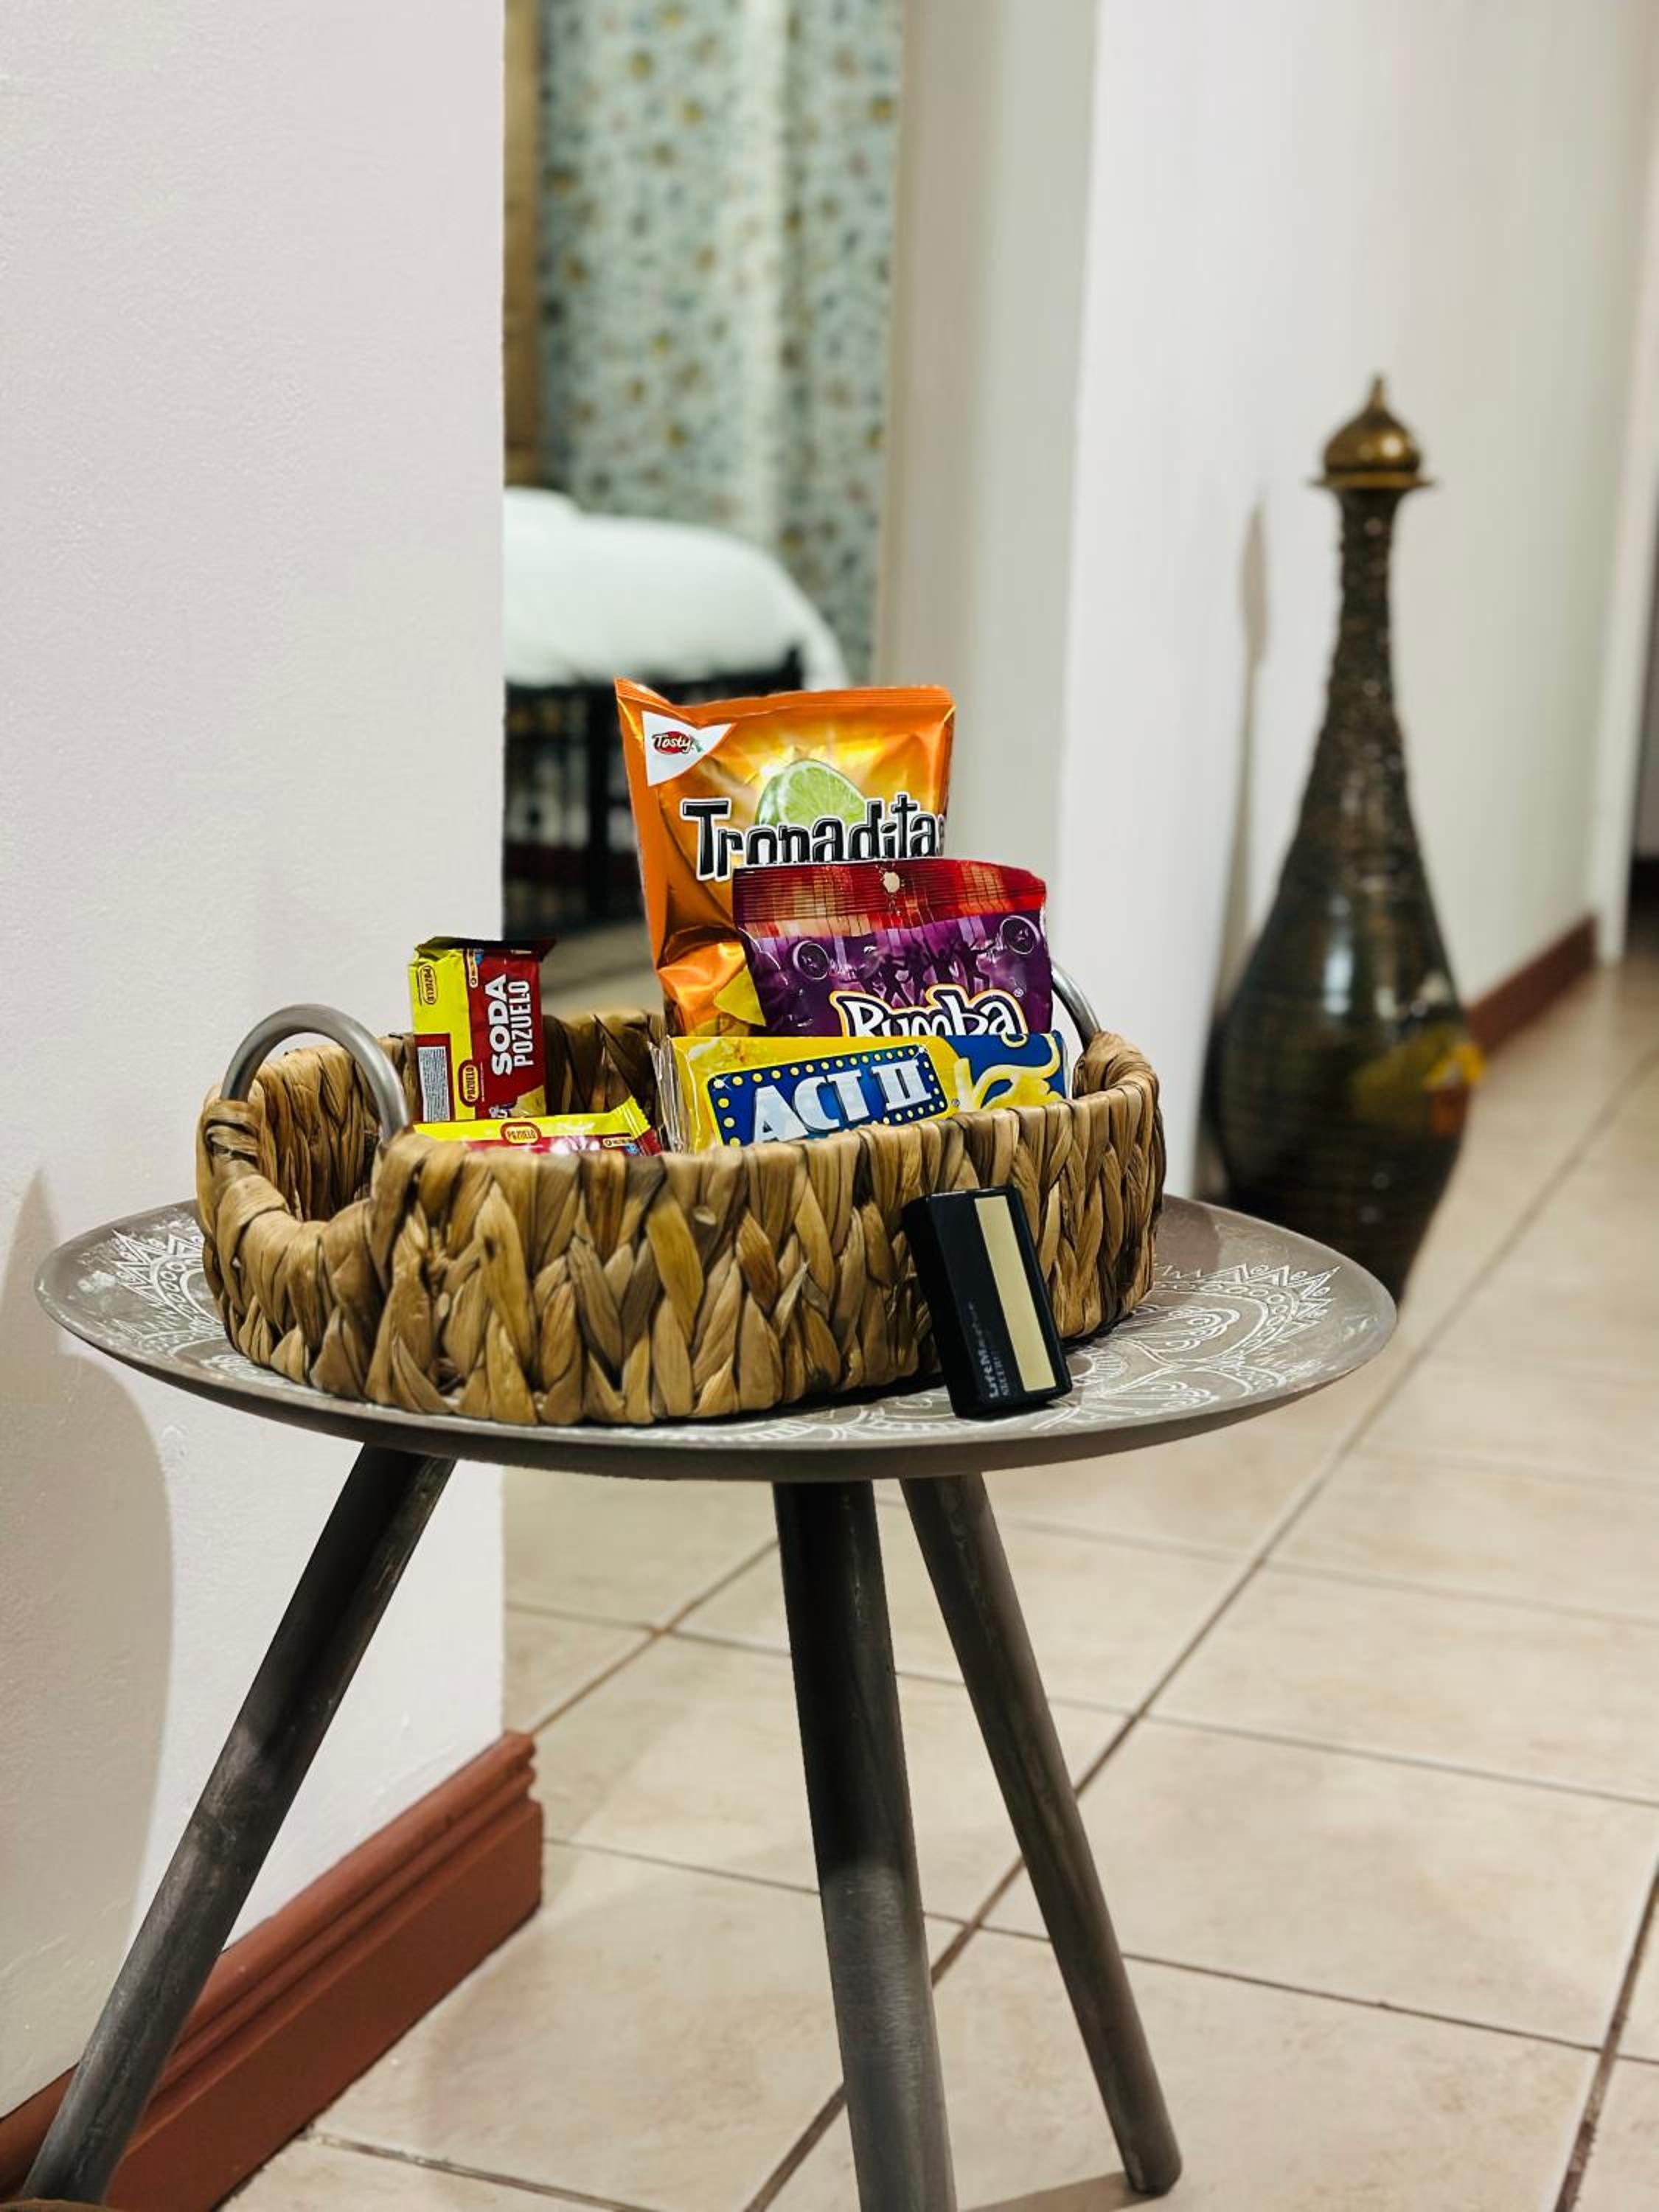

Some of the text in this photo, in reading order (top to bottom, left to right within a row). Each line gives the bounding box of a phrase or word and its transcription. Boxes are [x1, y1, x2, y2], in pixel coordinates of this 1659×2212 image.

[484, 973, 512, 1076] SODA
[507, 980, 535, 1067] POZUELO
[835, 988, 1026, 1042] Rumba
[753, 1059, 933, 1144] ACT II
